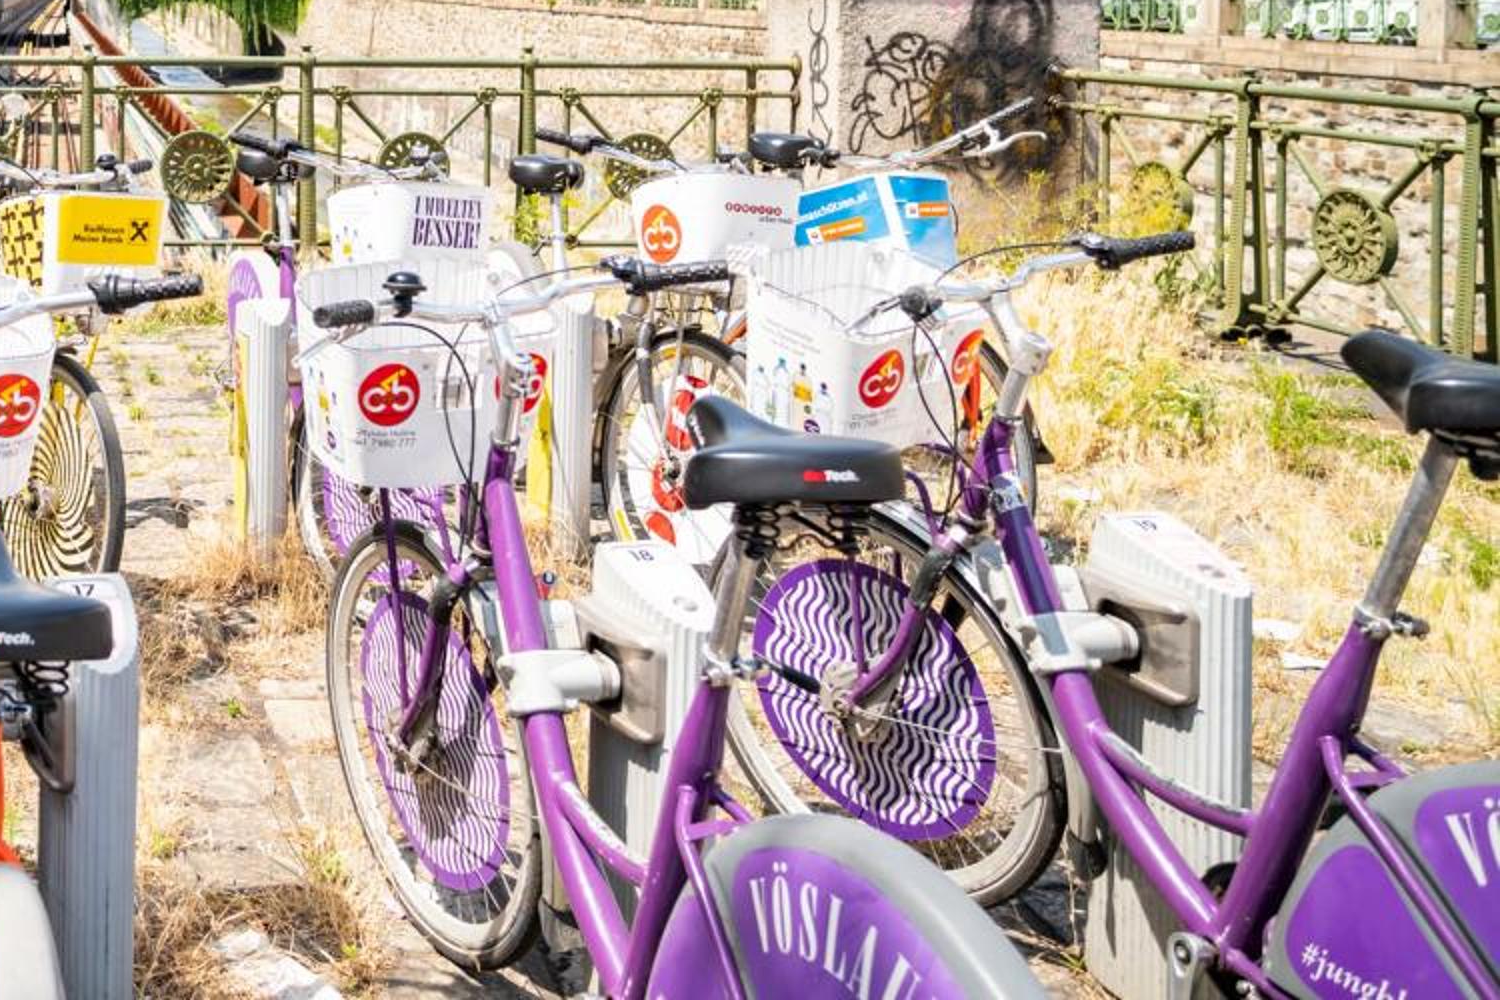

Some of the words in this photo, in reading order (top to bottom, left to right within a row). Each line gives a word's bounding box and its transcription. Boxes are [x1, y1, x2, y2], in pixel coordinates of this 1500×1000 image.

[415, 196, 481, 219] UMWELTEN
[412, 217, 480, 248] BESSER!
[628, 549, 654, 562] 18
[72, 584, 95, 597] 17
[750, 861, 938, 1000] VÖSLAU
